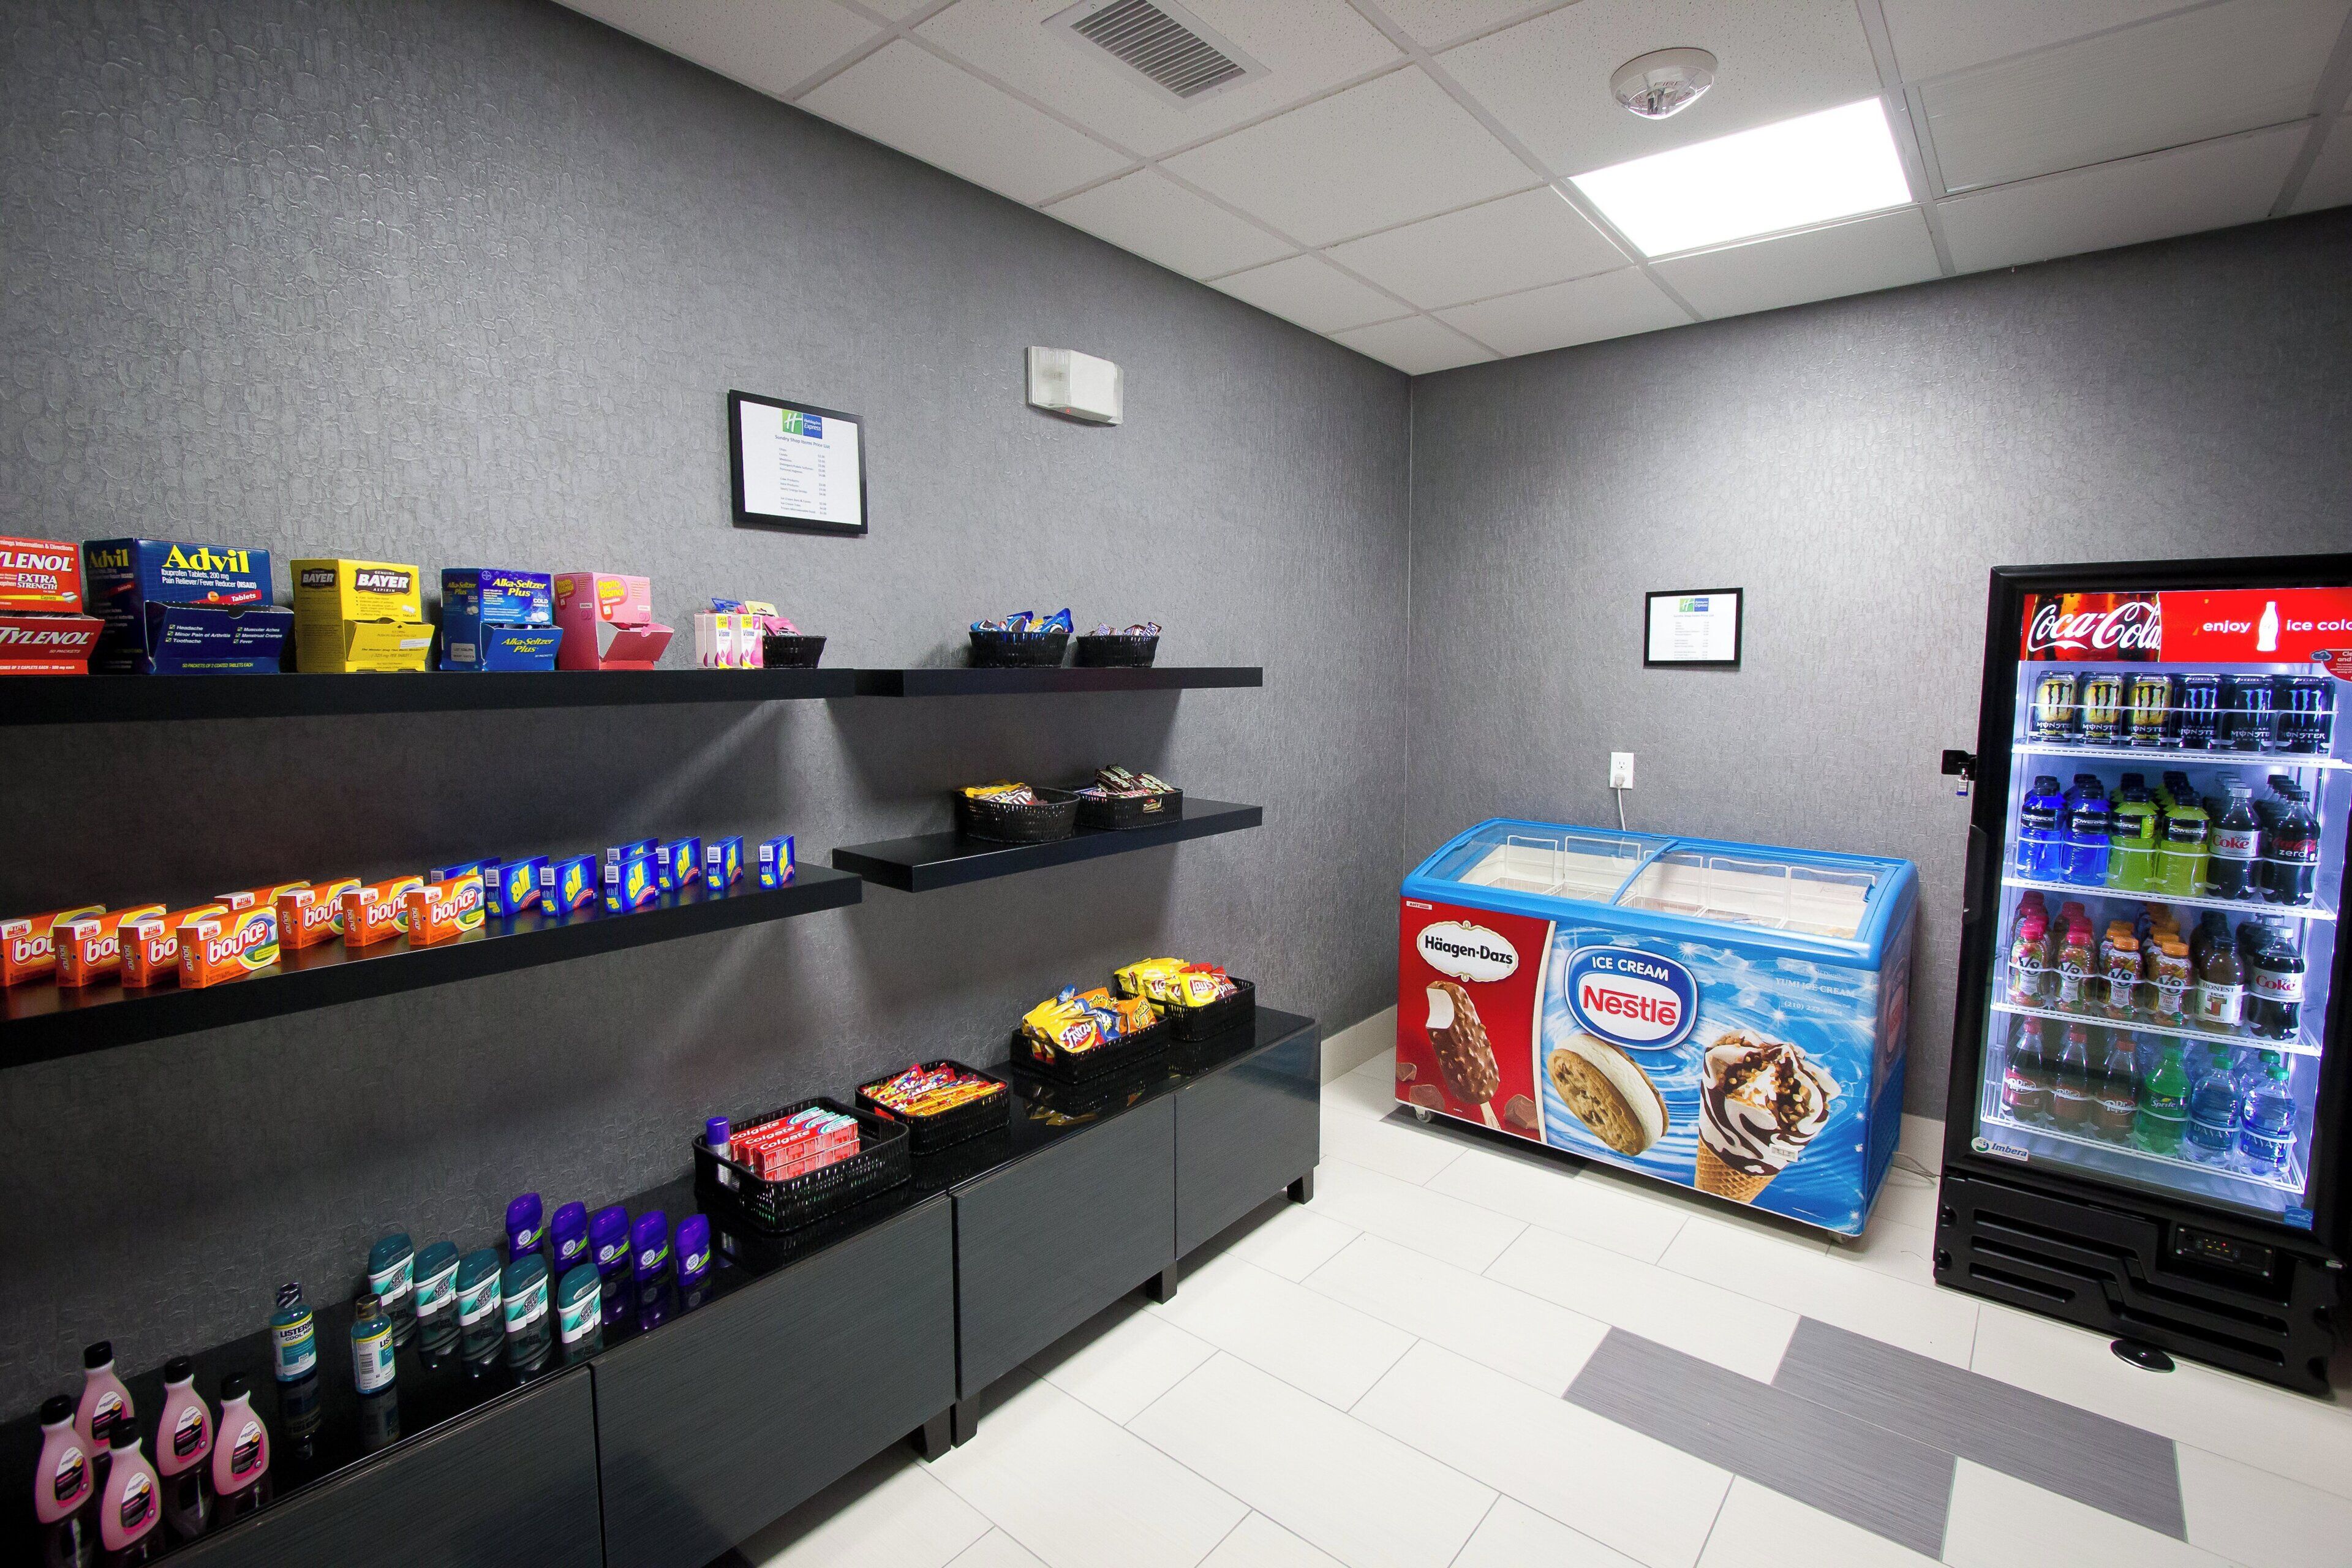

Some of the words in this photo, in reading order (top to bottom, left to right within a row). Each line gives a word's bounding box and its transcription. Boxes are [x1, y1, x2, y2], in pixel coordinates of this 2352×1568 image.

[89, 549, 129, 568] Advil
[162, 544, 250, 573] Advil
[18, 573, 57, 584] EXTRA
[175, 578, 214, 586] Reliever/Fever
[187, 570, 209, 579] Tablets,
[303, 573, 334, 582] BAYER
[356, 573, 409, 589] BAYER
[492, 578, 546, 589] Alka-Seltzer
[507, 588, 531, 597] Plus
[557, 584, 574, 594] Bismol
[598, 581, 620, 590] Pepto
[600, 587, 624, 598] Bismol
[232, 593, 256, 601] Tablets
[0, 627, 91, 644] TYLENOL
[2027, 601, 2162, 652] Coca-Cola
[2203, 620, 2250, 633] enjoy
[2286, 619, 2314, 631] ice
[2212, 835, 2249, 850] Coke
[677, 845, 690, 878] all
[727, 844, 736, 877] all
[779, 843, 788, 876] all
[511, 865, 530, 903] all
[565, 864, 582, 902] all
[628, 861, 644, 899] all
[433, 890, 475, 923] bounce
[282, 911, 292, 934] bounce
[347, 908, 356, 932] bounce
[412, 908, 421, 930] bounce
[209, 922, 265, 963] bounce
[1425, 935, 1513, 965] Häagen-Dazs
[59, 944, 69, 971] bounce
[124, 944, 134, 970] bounce
[182, 946, 194, 971] bounce
[1593, 956, 1613, 970] ICE
[1618, 959, 1668, 981] CREAM
[1191, 980, 1212, 993] Lay's
[1802, 982, 1818, 991] ICE
[1820, 986, 1856, 997] CREAM
[2203, 982, 2234, 992] HONEST
[2256, 975, 2296, 991] Coke
[1583, 985, 1677, 1026] Nestlé
[1785, 1001, 1804, 1010] (210)
[1059, 1022, 1091, 1049] Fritos
[2151, 1098, 2176, 1107] Sprite
[730, 1121, 780, 1140] Colgate
[745, 1126, 795, 1145] Colgate
[760, 1129, 810, 1150] Colgate
[1991, 1143, 2027, 1156] Imbera
